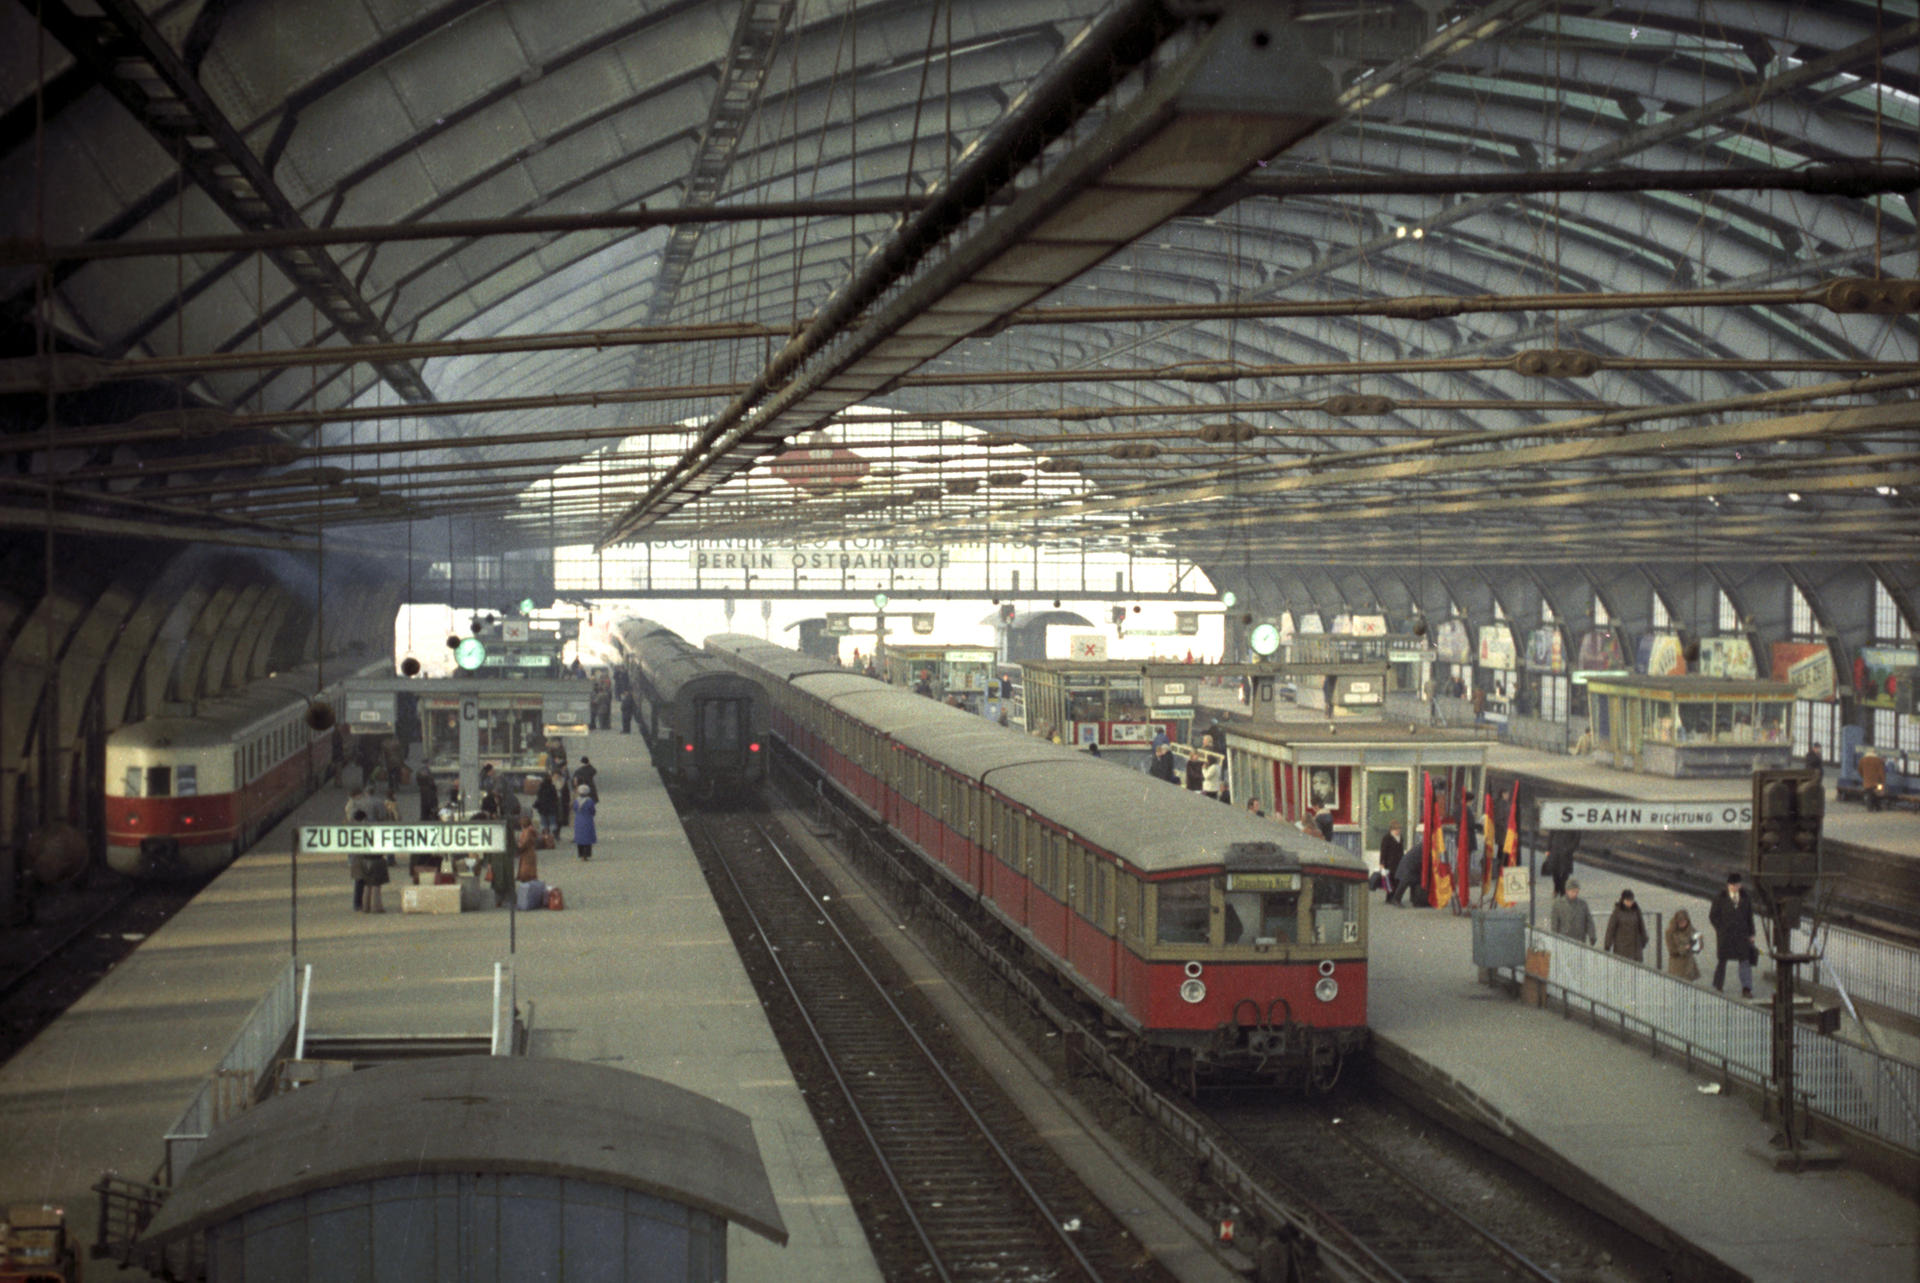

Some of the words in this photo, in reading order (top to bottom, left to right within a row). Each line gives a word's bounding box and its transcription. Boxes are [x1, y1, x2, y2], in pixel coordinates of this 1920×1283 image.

[700, 553, 773, 569] BERLIN
[792, 553, 949, 569] OSTBAHNHOF
[463, 701, 475, 721] C
[1561, 807, 1642, 824] S-BAHN
[1650, 811, 1713, 824] RICHTUNG
[1722, 807, 1753, 824] OS
[306, 827, 332, 848] ZU
[337, 827, 375, 848] DEN
[1344, 923, 1357, 942] 14
